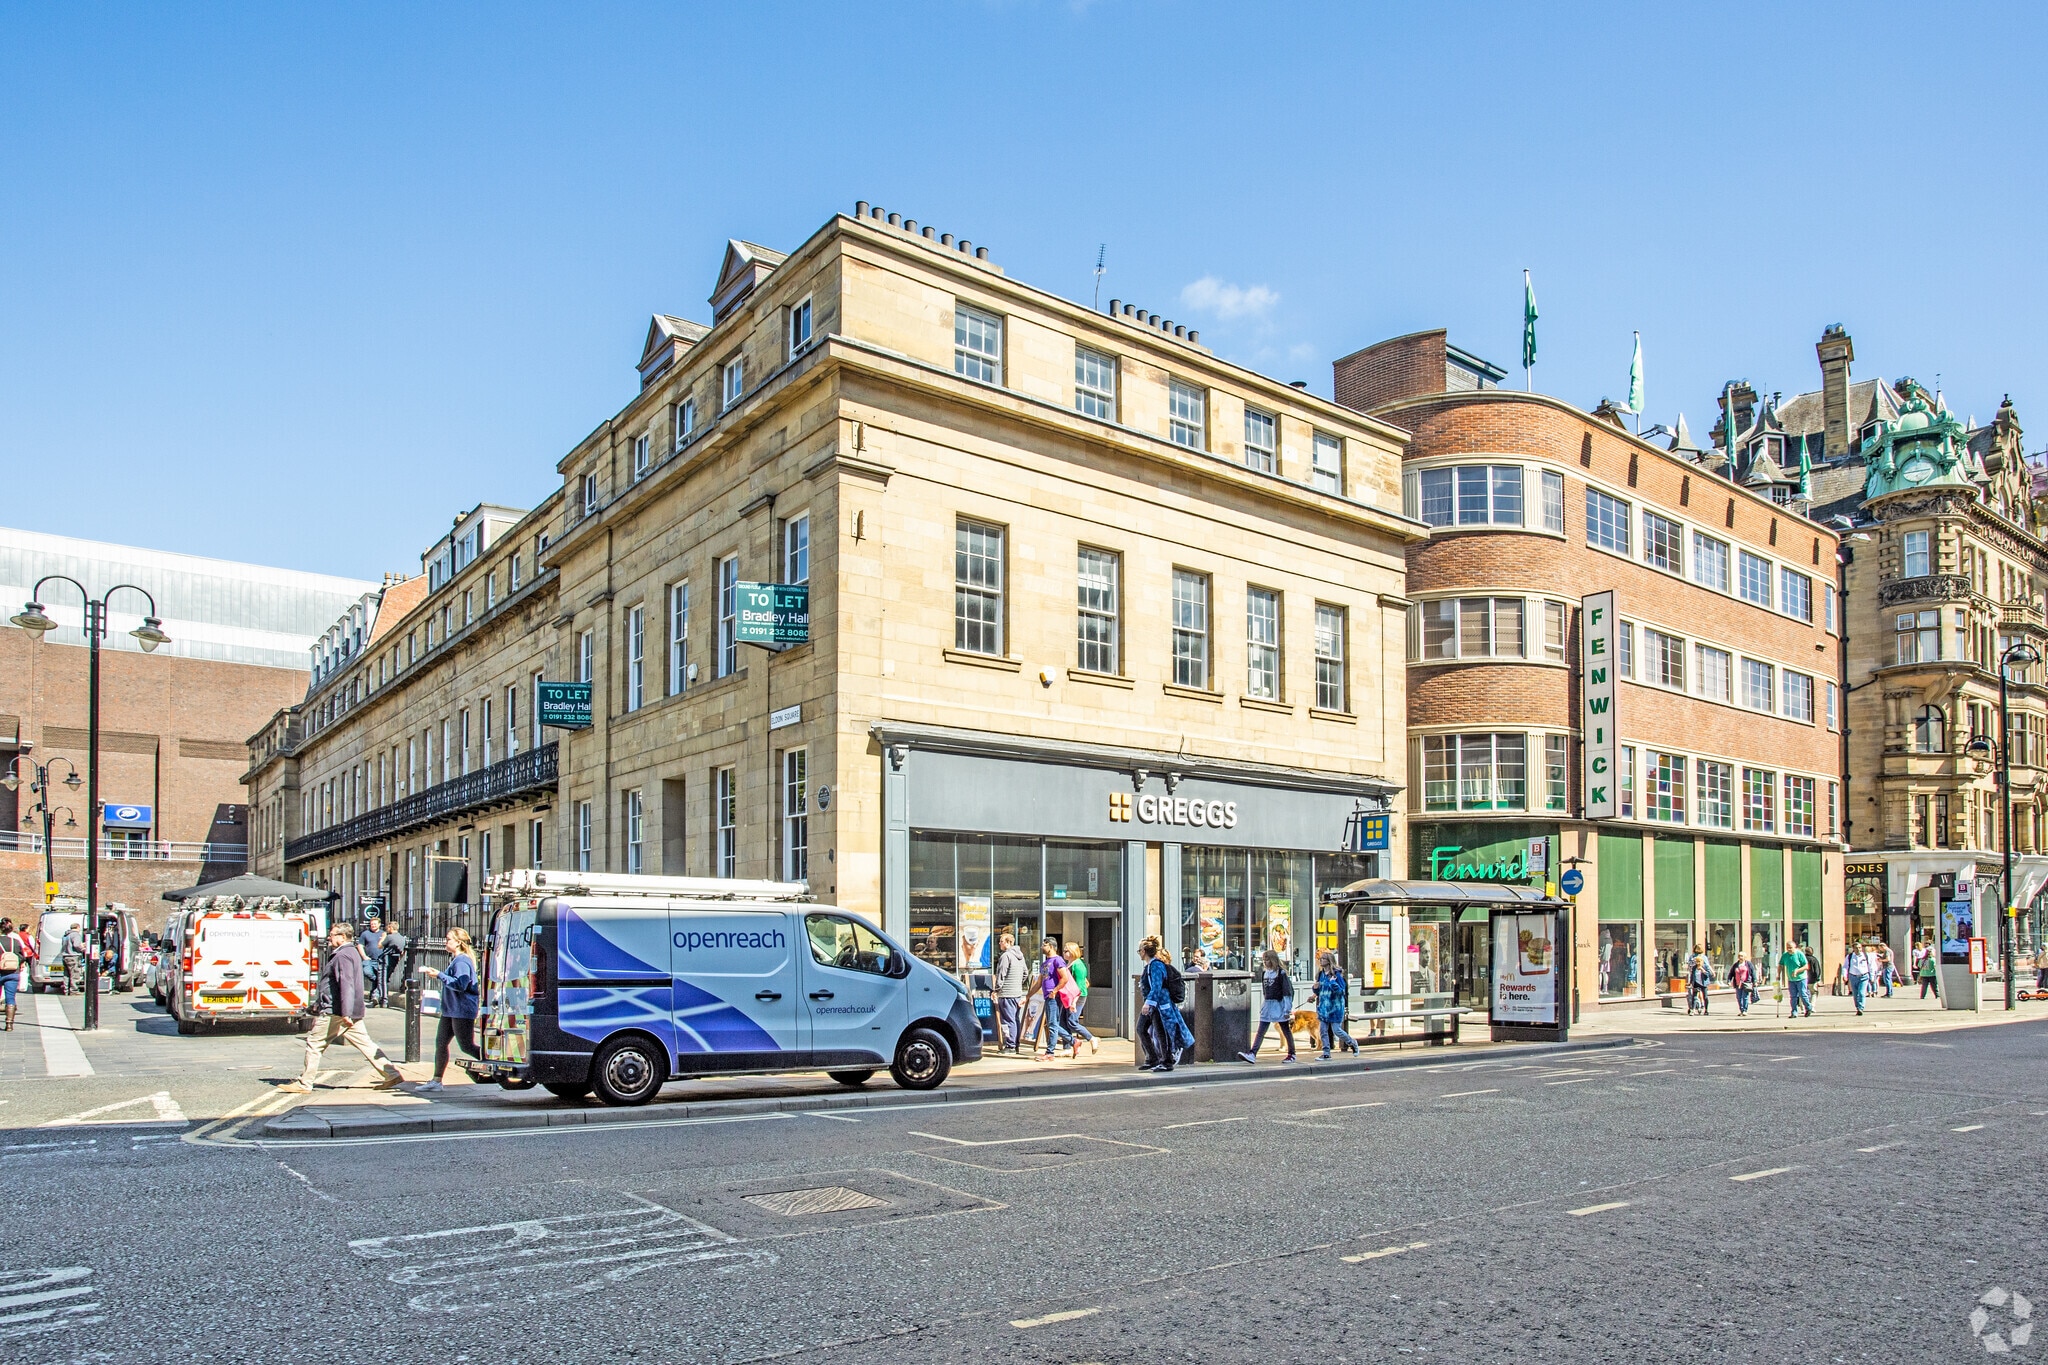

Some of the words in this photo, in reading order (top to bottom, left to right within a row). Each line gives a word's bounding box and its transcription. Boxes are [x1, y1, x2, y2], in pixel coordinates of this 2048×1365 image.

[748, 593, 769, 606] TO
[775, 595, 804, 608] LET
[742, 610, 785, 626] Bradley
[788, 613, 809, 624] Hall
[769, 628, 785, 636] 232
[787, 629, 809, 637] 8080
[548, 690, 563, 699] TO
[567, 690, 589, 700] LET
[543, 701, 575, 713] Bradley
[1588, 608, 1609, 803] FENWICK
[784, 710, 799, 721] SQUARE
[1138, 795, 1238, 829] GREGGS
[1845, 864, 1884, 874] ONES
[209, 930, 250, 938] openreach
[673, 929, 785, 952] openreach
[1500, 983, 1536, 992] Rewards
[1500, 992, 1507, 1000] is
[1509, 992, 1530, 1000] here.
[974, 999, 990, 1007] OPEN
[816, 1004, 877, 1015] openreach.co.uk
[976, 1007, 991, 1016] LATE
